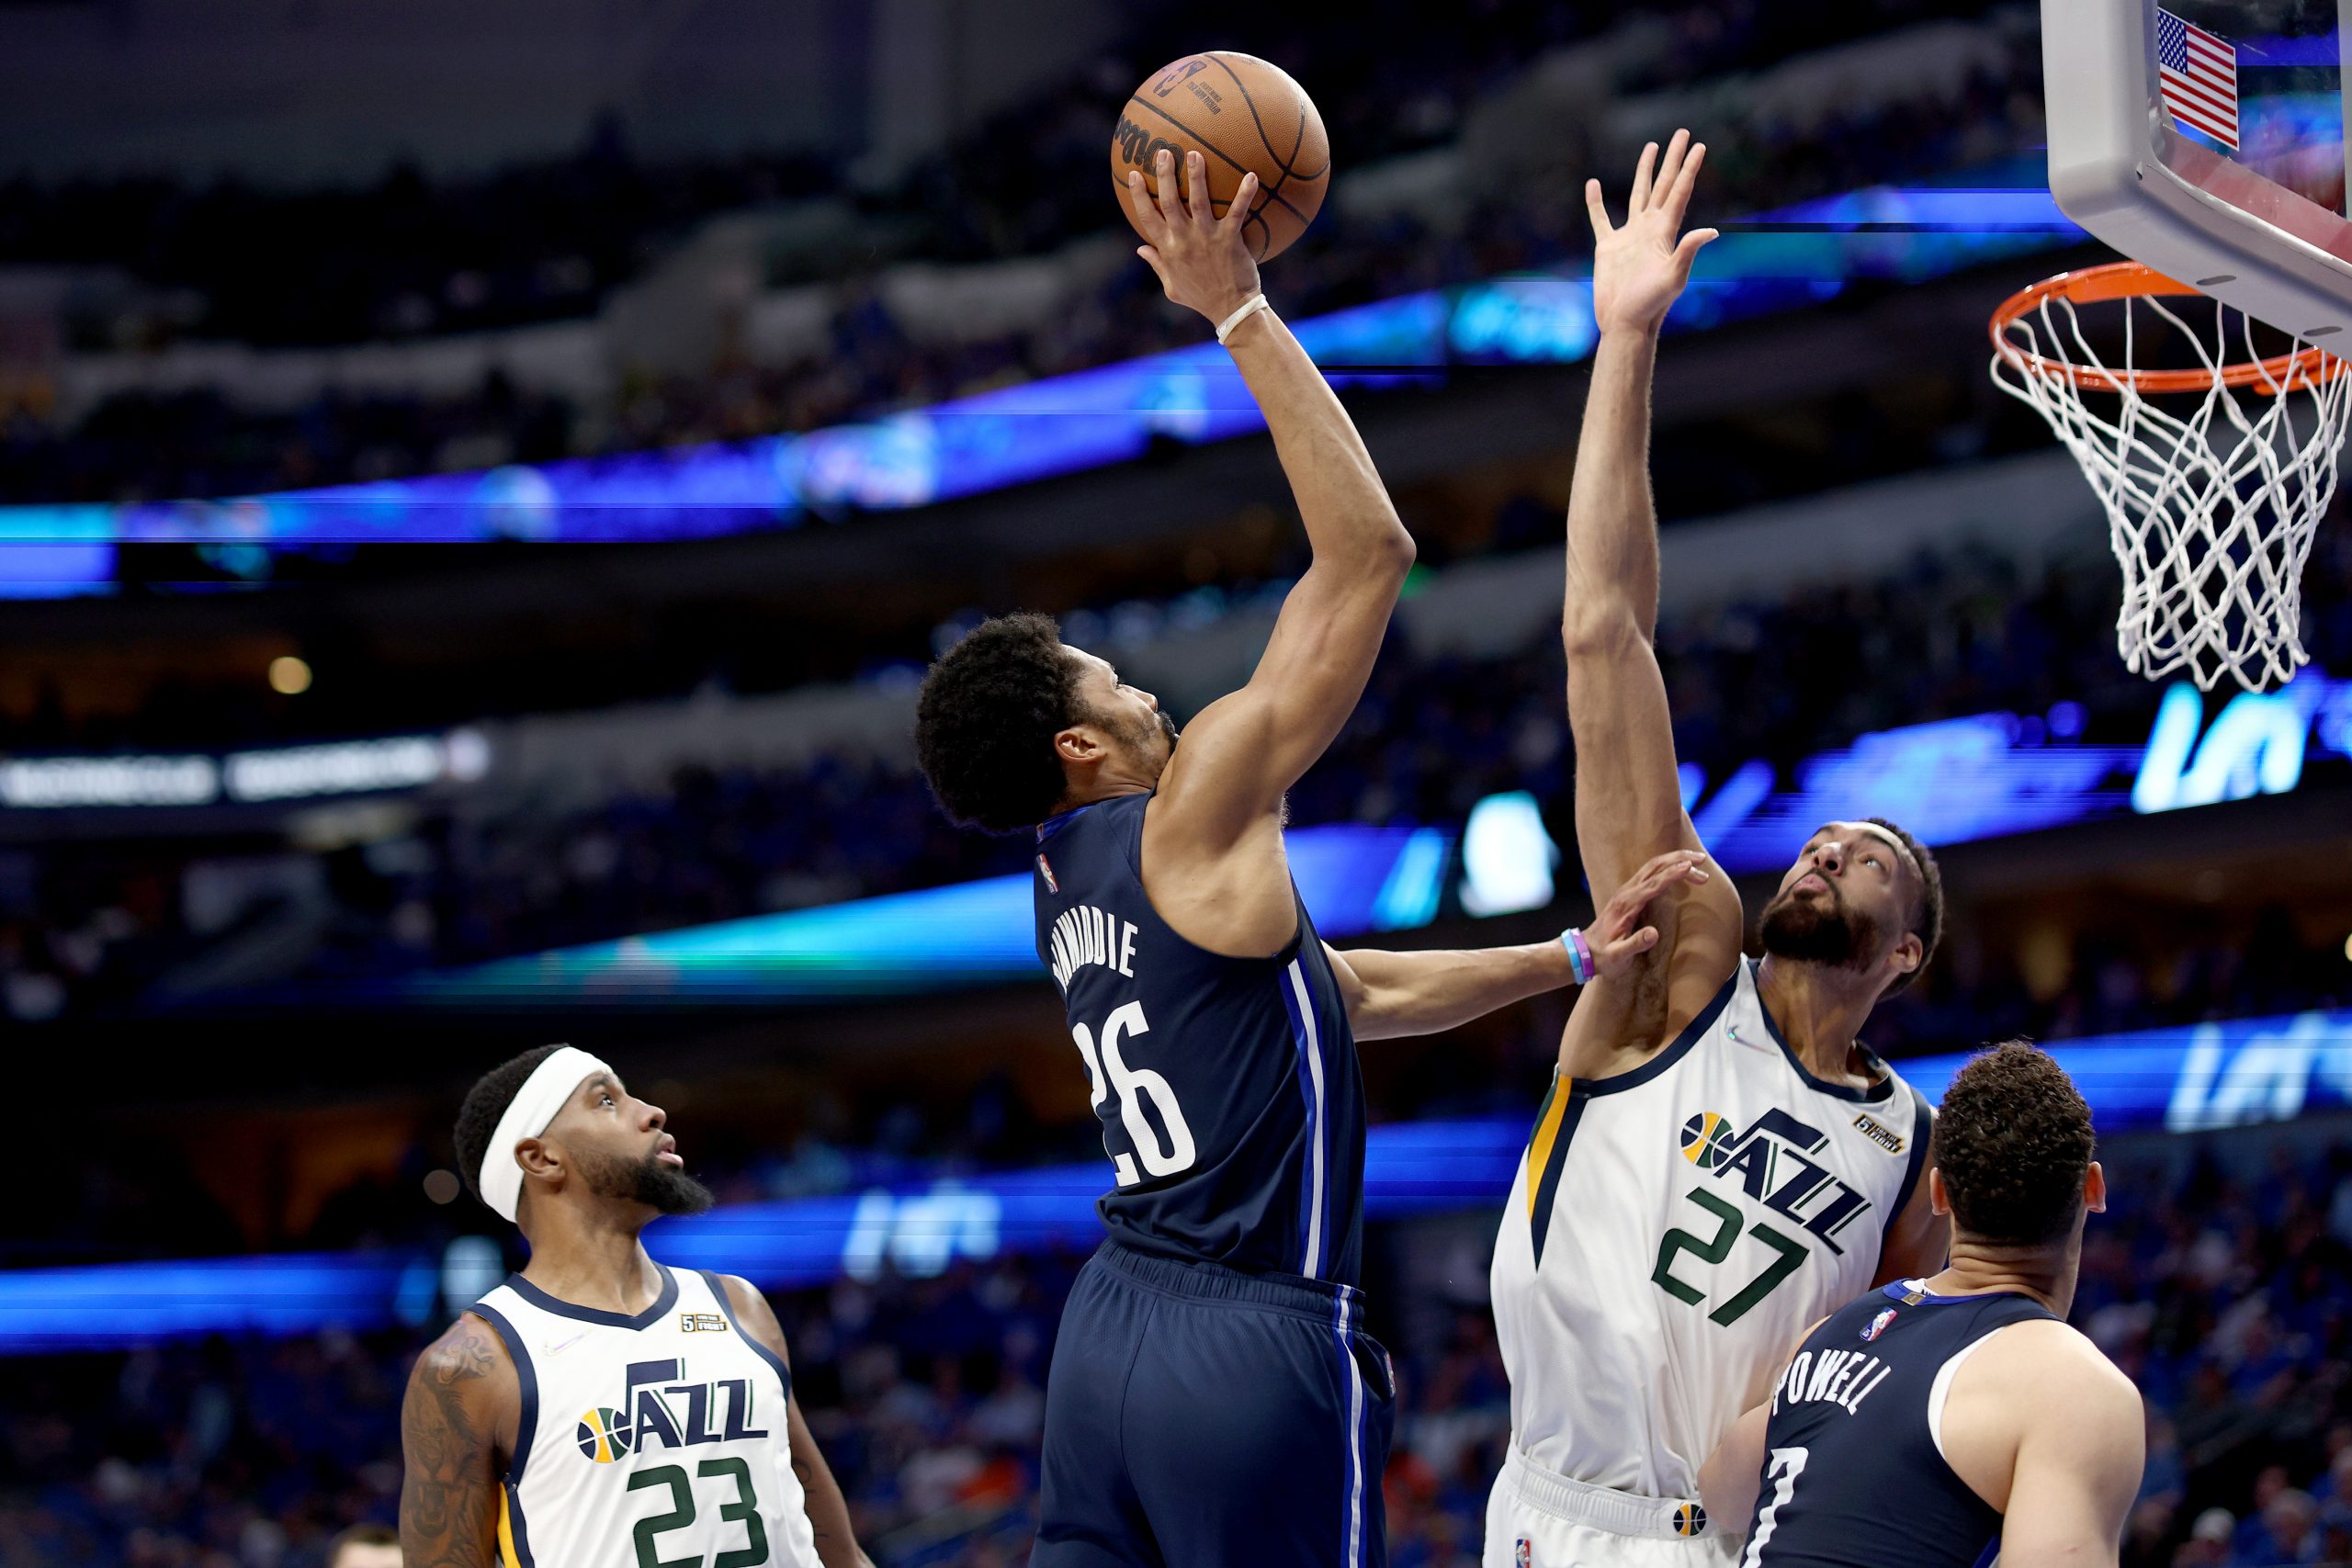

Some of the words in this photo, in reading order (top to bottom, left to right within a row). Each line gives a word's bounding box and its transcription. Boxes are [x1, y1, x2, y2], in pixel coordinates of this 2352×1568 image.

[1072, 1000, 1196, 1186] 26
[1869, 1131, 1899, 1152] FIGHT
[1680, 1107, 1872, 1256] JAZZ
[1650, 1186, 1810, 1327] 27
[683, 1314, 695, 1331] 5
[577, 1358, 768, 1463] JAZZ
[1772, 1348, 1891, 1416] POWELL
[627, 1457, 770, 1568] 23
[1742, 1446, 1809, 1568] 7
